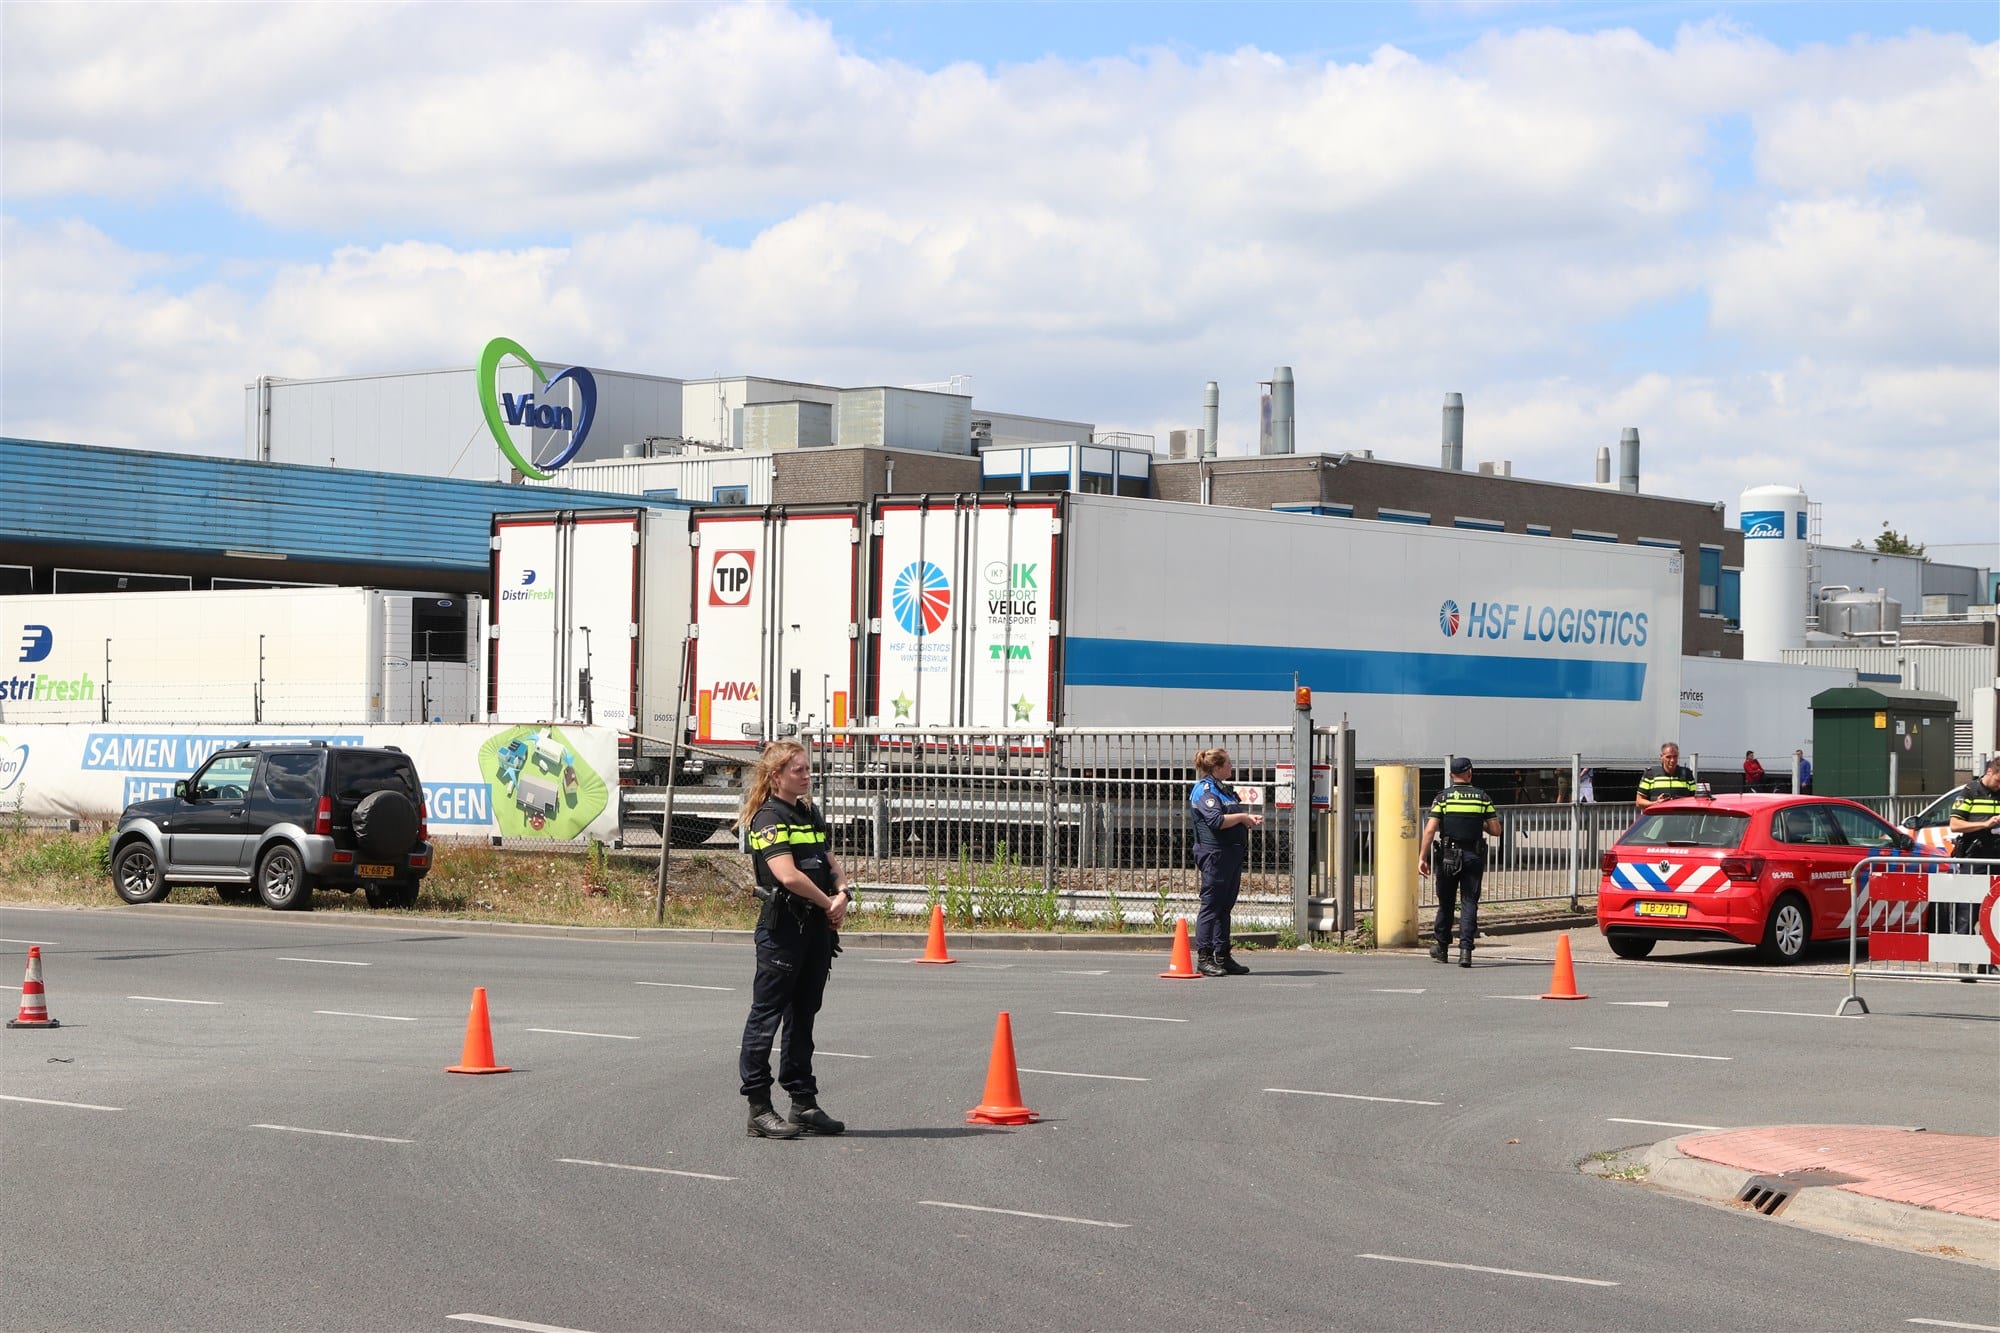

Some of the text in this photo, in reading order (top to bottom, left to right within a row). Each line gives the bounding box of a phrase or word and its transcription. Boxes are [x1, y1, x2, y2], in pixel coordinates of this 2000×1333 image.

[503, 393, 572, 430] Vion
[1744, 523, 1783, 537] Linde
[716, 567, 749, 592] TIP
[1012, 563, 1037, 588] IK
[502, 589, 554, 601] DistriFresh
[988, 589, 1037, 601] SUPPORT
[988, 600, 1036, 615] VEILIG
[1467, 602, 1648, 647] HSF LOGISTICS
[889, 642, 905, 651] HSF
[989, 644, 1032, 660] TVM
[0, 672, 94, 701] striFresh
[712, 681, 759, 701] HNA
[1680, 687, 1704, 701] ervices
[88, 738, 177, 769] SAMEN
[0, 757, 17, 772] ion
[423, 787, 486, 820] RGEN
[1811, 871, 1847, 880] BRANDWEER
[1645, 902, 1682, 913] TB-791-T
